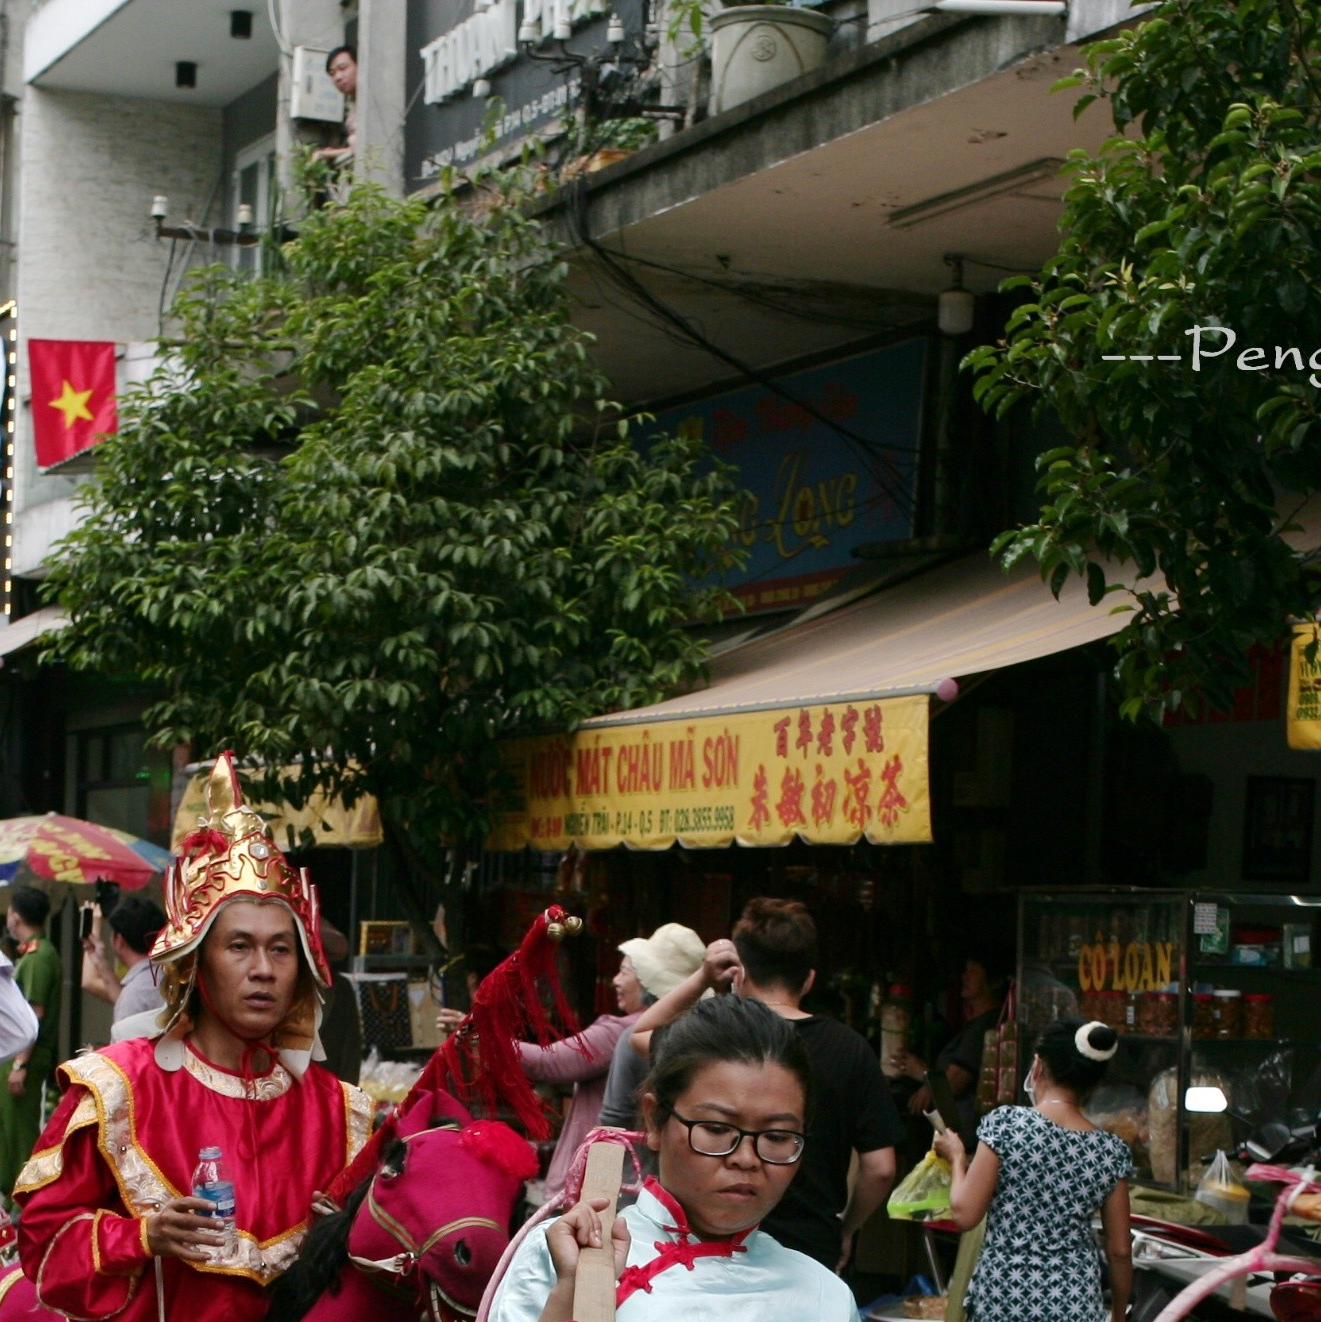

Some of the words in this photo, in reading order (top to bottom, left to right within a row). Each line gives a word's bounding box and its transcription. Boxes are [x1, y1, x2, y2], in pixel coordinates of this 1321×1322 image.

[616, 729, 664, 794] CHÂU
[1079, 929, 1106, 992] CÔ
[1112, 941, 1172, 992] LOAN
